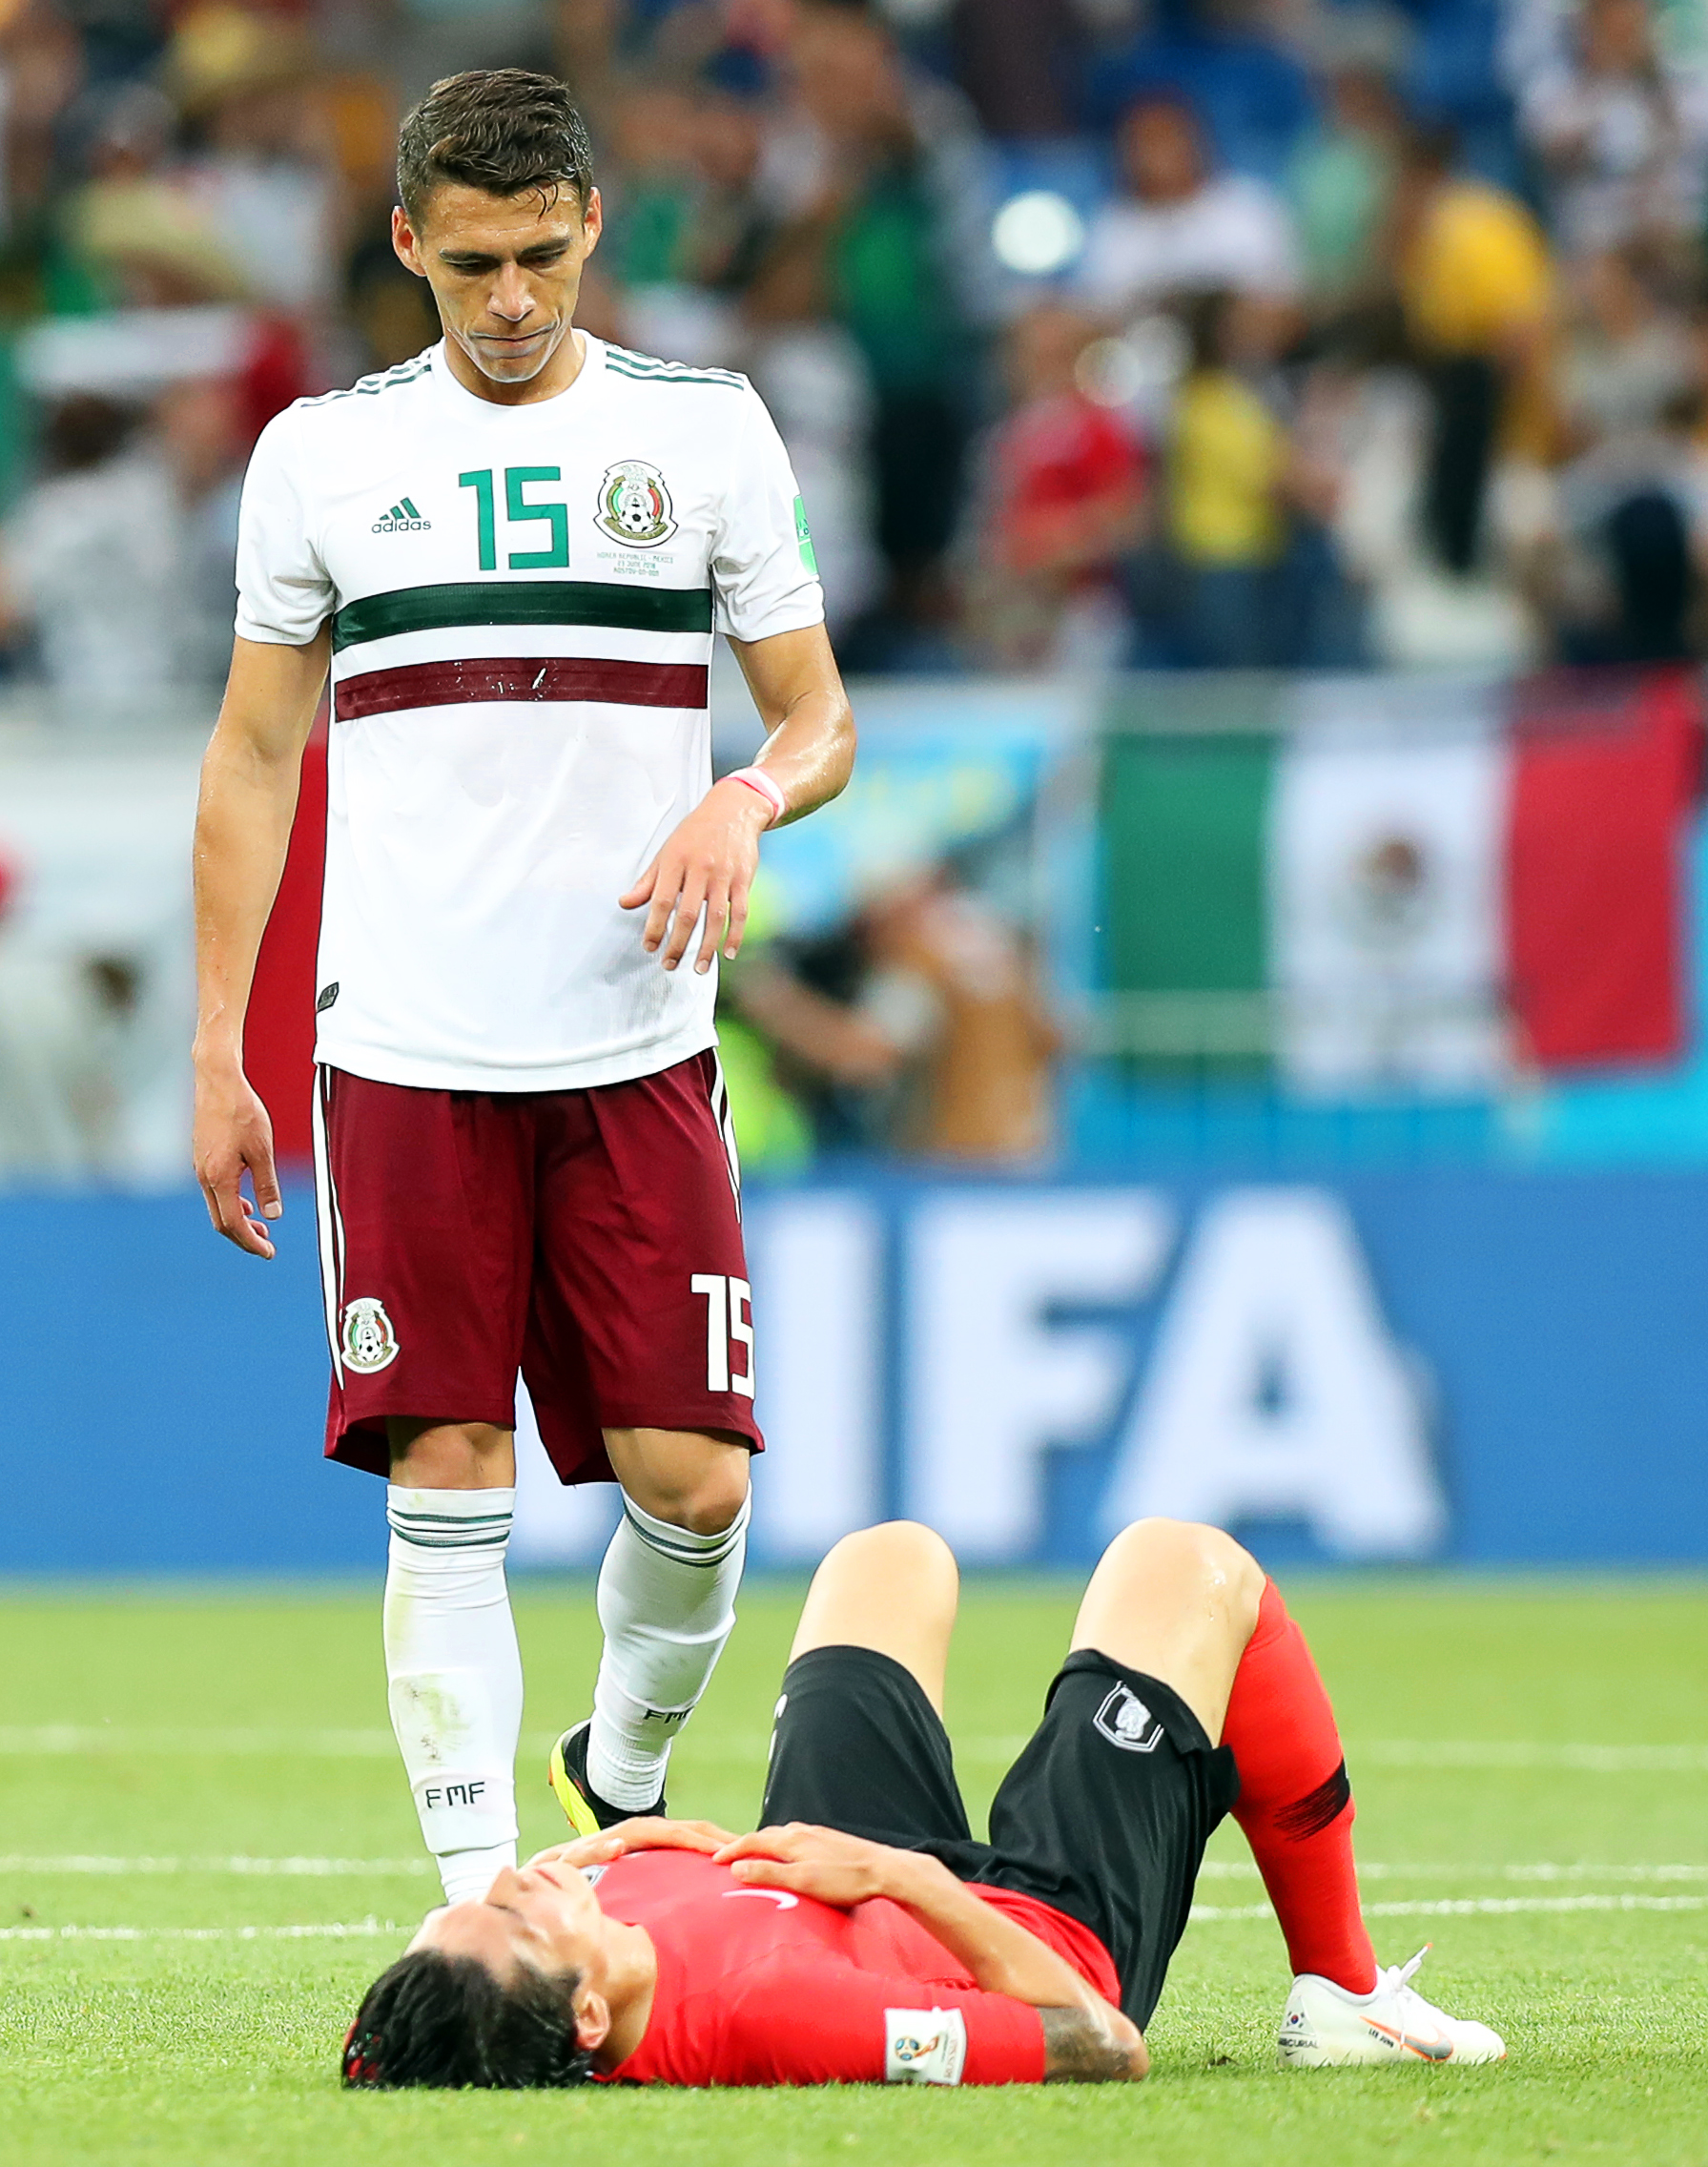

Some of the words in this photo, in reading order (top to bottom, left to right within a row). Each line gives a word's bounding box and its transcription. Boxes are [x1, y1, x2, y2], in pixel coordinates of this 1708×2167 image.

[371, 518, 432, 534] adidas
[458, 465, 570, 571] 15
[513, 1181, 1445, 1562] IFA
[690, 1273, 755, 1400] 15
[425, 1781, 485, 1808] FMF
